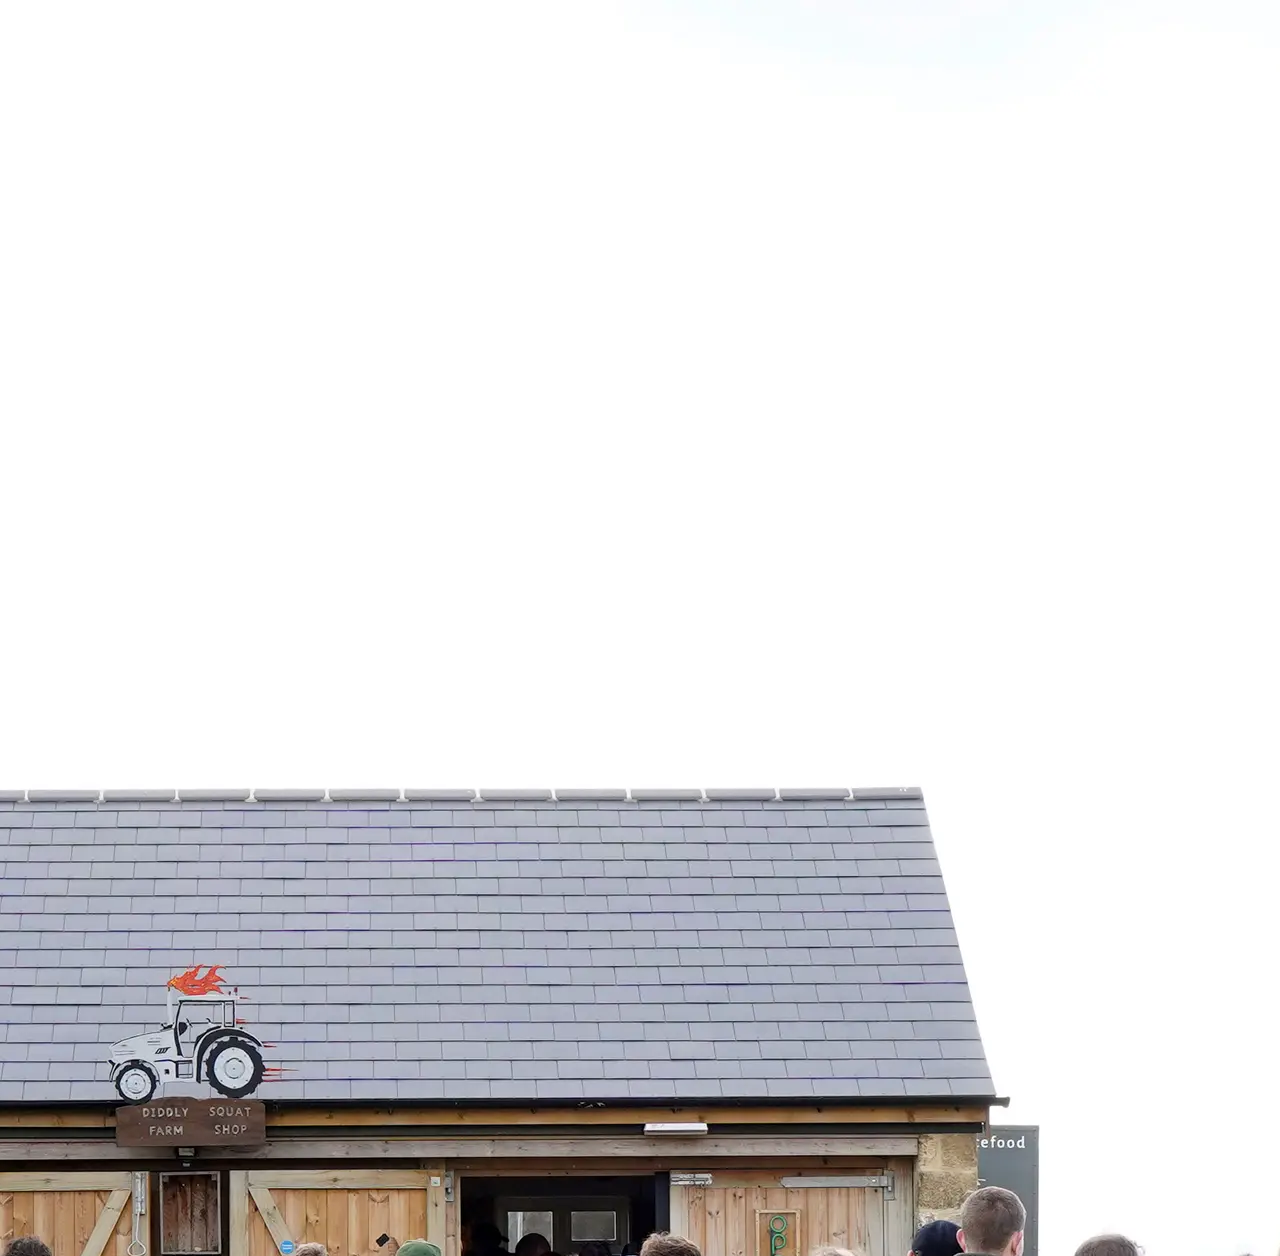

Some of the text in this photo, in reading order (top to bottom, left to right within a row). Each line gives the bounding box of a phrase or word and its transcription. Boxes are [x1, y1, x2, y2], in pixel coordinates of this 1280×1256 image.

[142, 1106, 252, 1118] DIDDLY SQUAT
[149, 1124, 248, 1136] FARM SHOP
[977, 1135, 1026, 1149] efood
